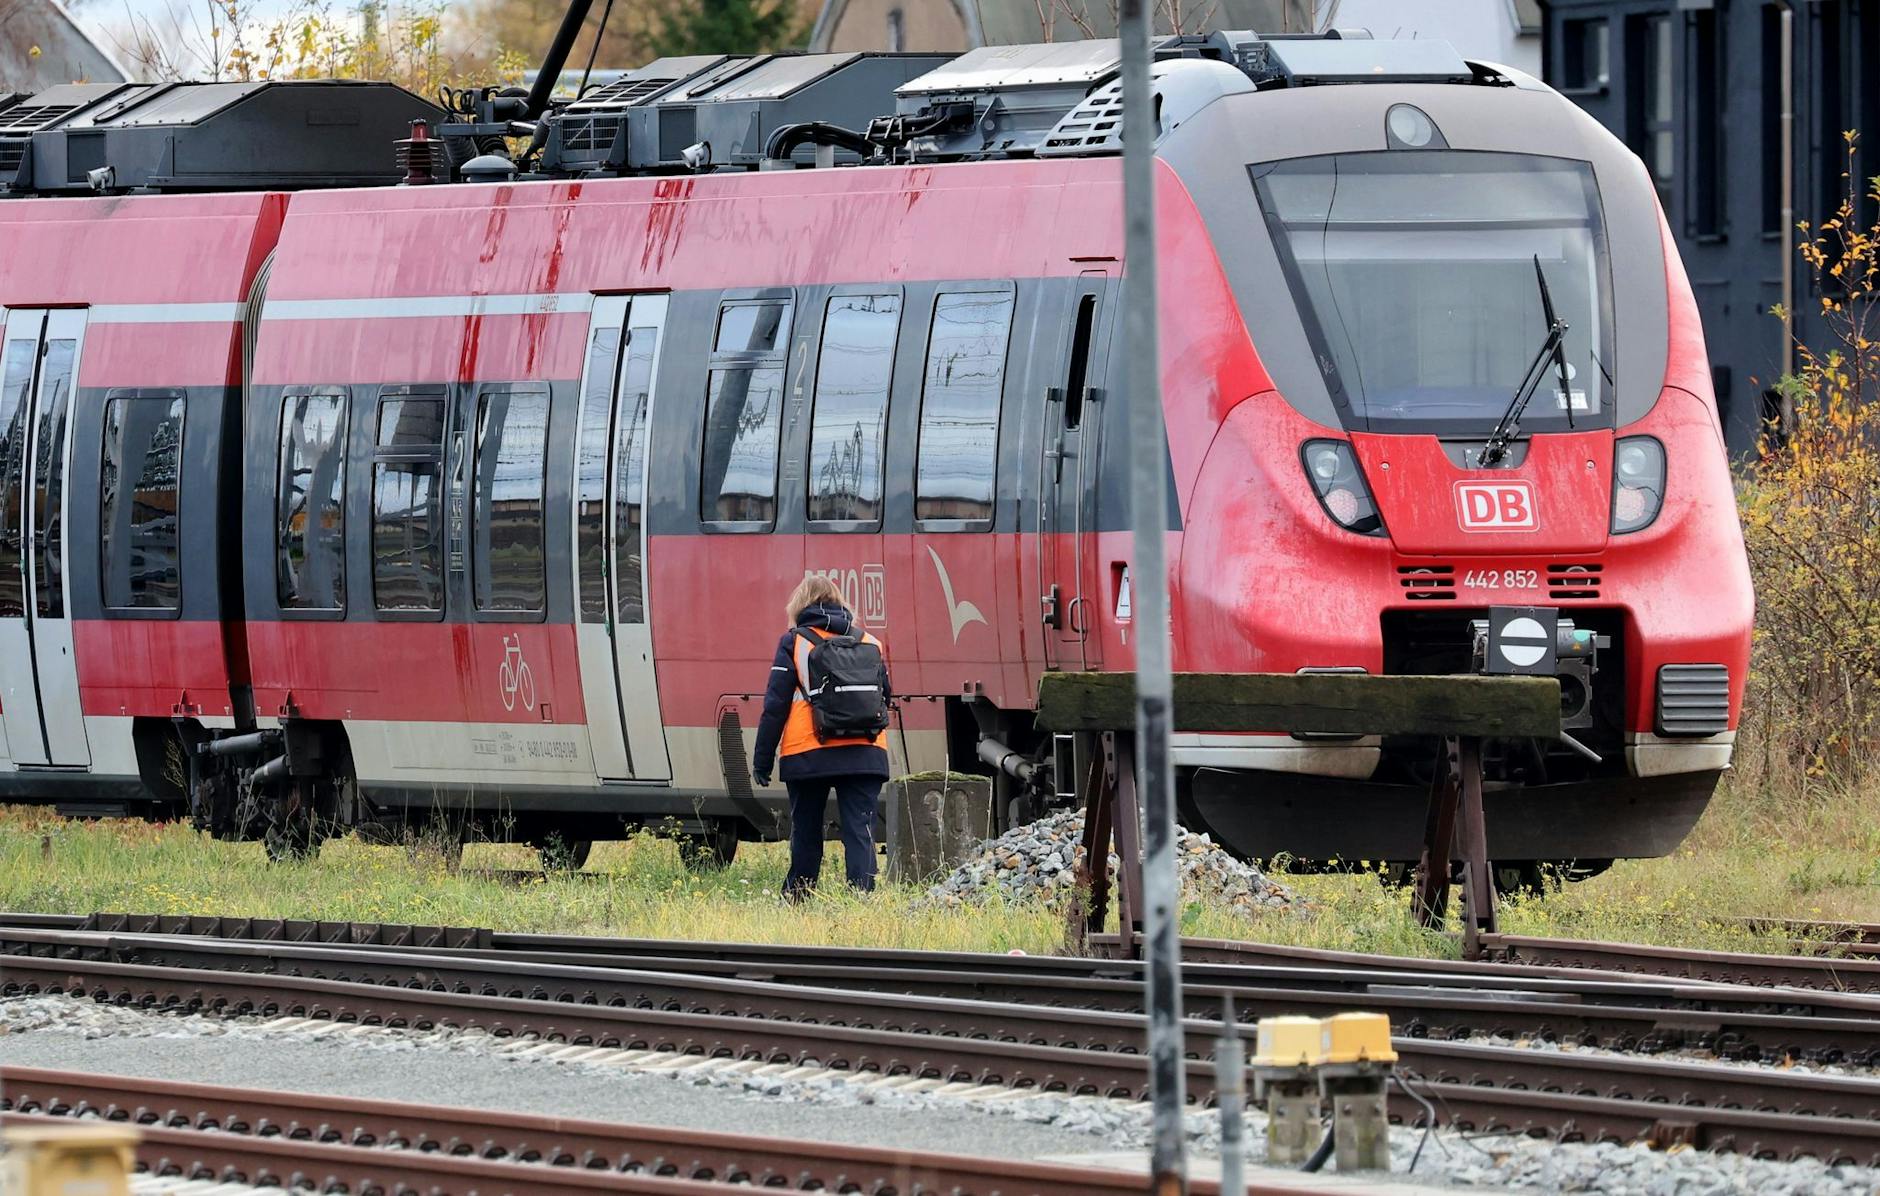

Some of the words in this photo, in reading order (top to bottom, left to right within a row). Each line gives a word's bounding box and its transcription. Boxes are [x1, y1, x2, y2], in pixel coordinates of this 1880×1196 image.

[793, 341, 807, 395] 2
[452, 436, 464, 489] 2
[1465, 489, 1528, 523] DB
[865, 576, 884, 617] DB
[1463, 569, 1499, 589] 442
[1503, 569, 1538, 589] 852
